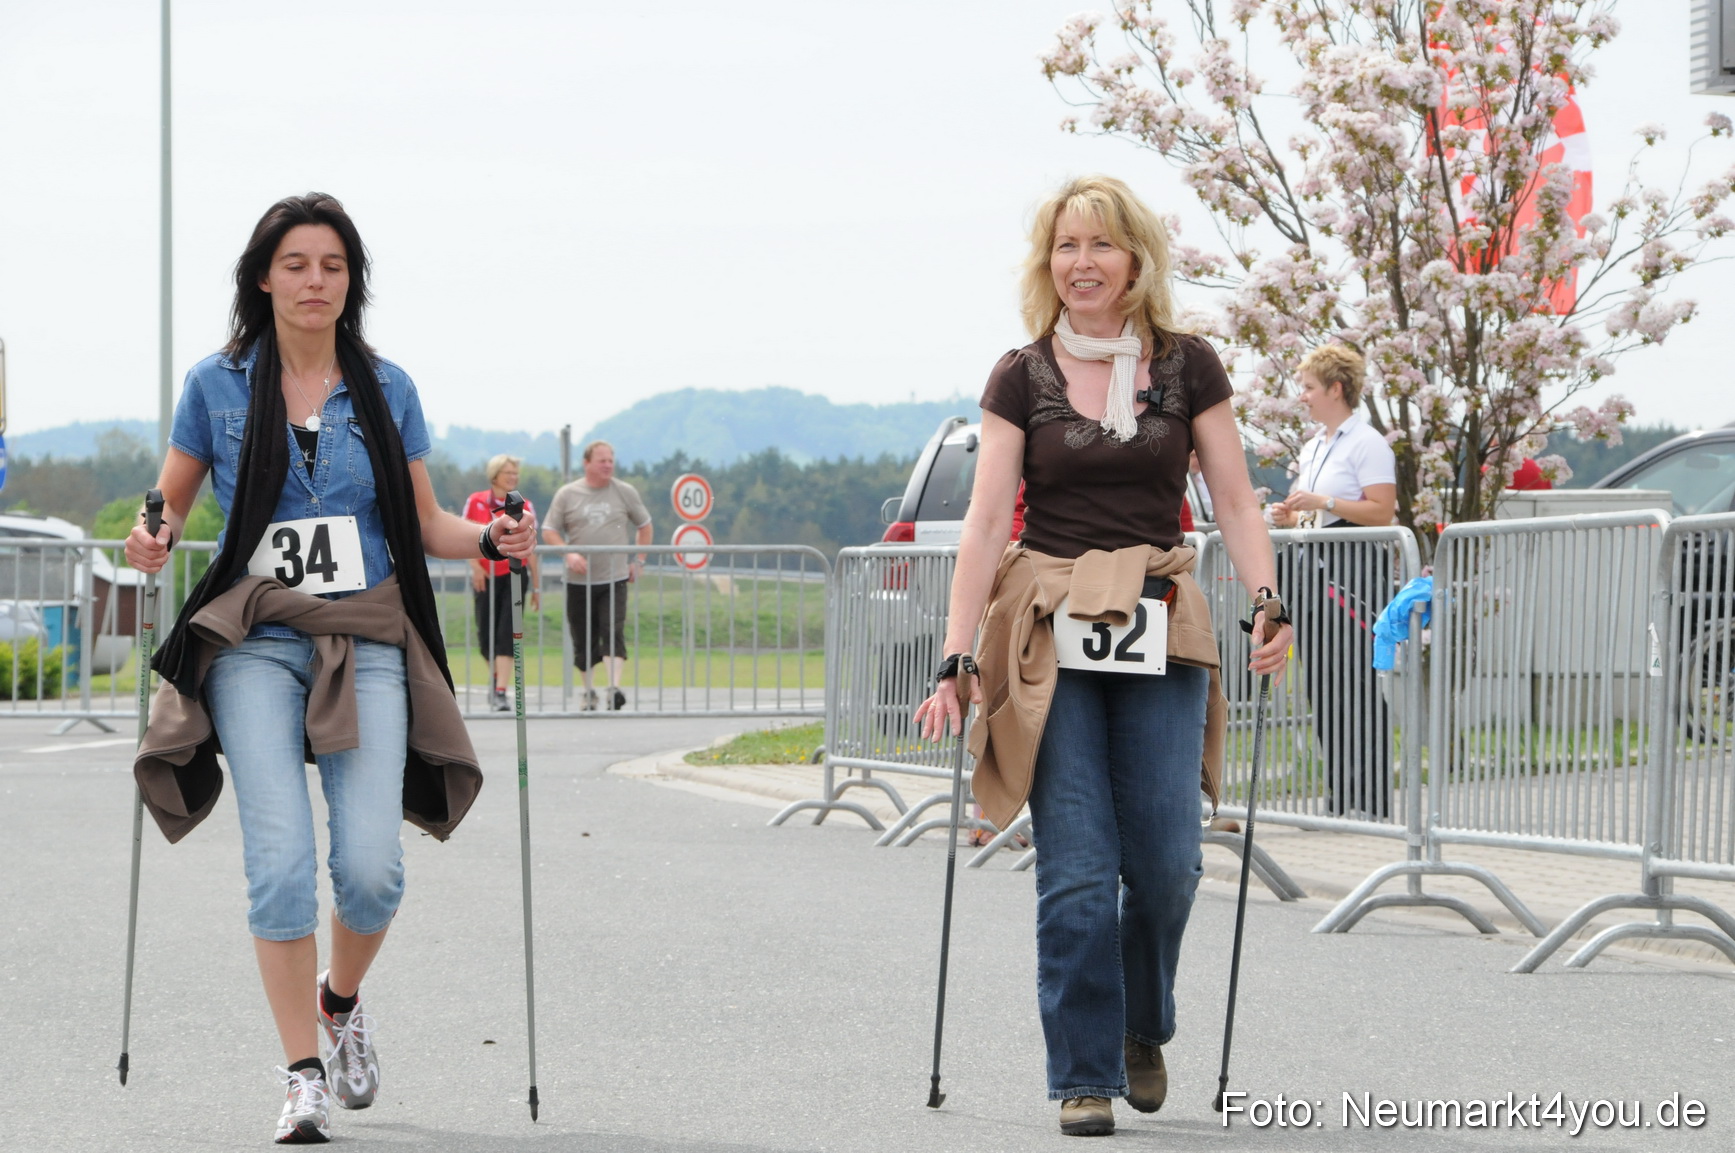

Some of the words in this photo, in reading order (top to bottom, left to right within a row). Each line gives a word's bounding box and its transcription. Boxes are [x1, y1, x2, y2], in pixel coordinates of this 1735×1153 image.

[682, 488, 704, 508] 60
[272, 523, 338, 588] 34
[1082, 602, 1147, 663] 32
